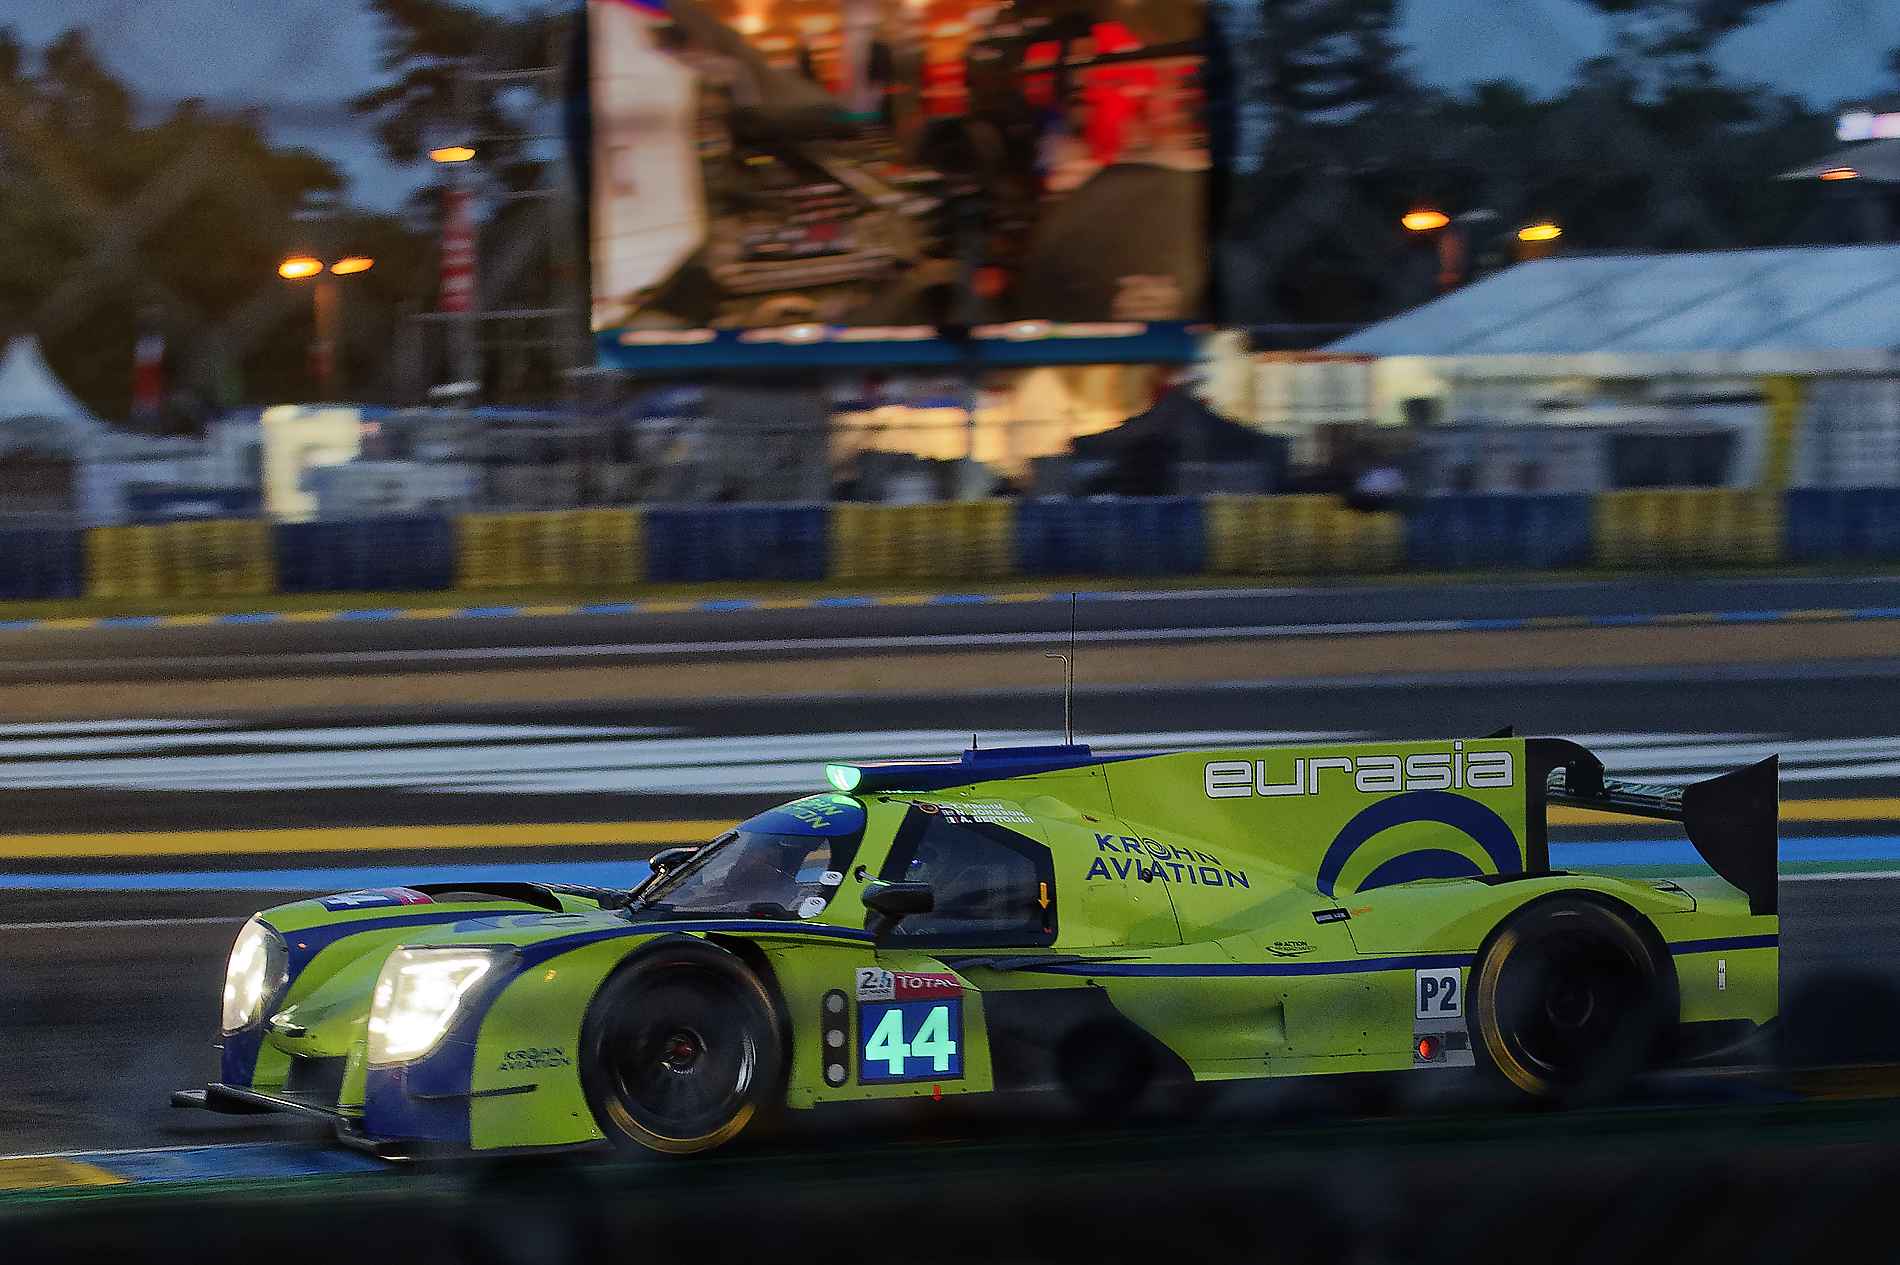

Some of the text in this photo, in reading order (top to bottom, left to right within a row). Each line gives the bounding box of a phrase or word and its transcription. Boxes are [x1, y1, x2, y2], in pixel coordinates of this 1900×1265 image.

[1203, 739, 1514, 799] eurasia
[1094, 833, 1222, 866] KROHN
[1085, 856, 1250, 889] AVIATION
[895, 974, 961, 989] TOTAL
[1421, 977, 1457, 1011] P2
[503, 1047, 564, 1060] KROHN
[865, 1006, 957, 1075] 44
